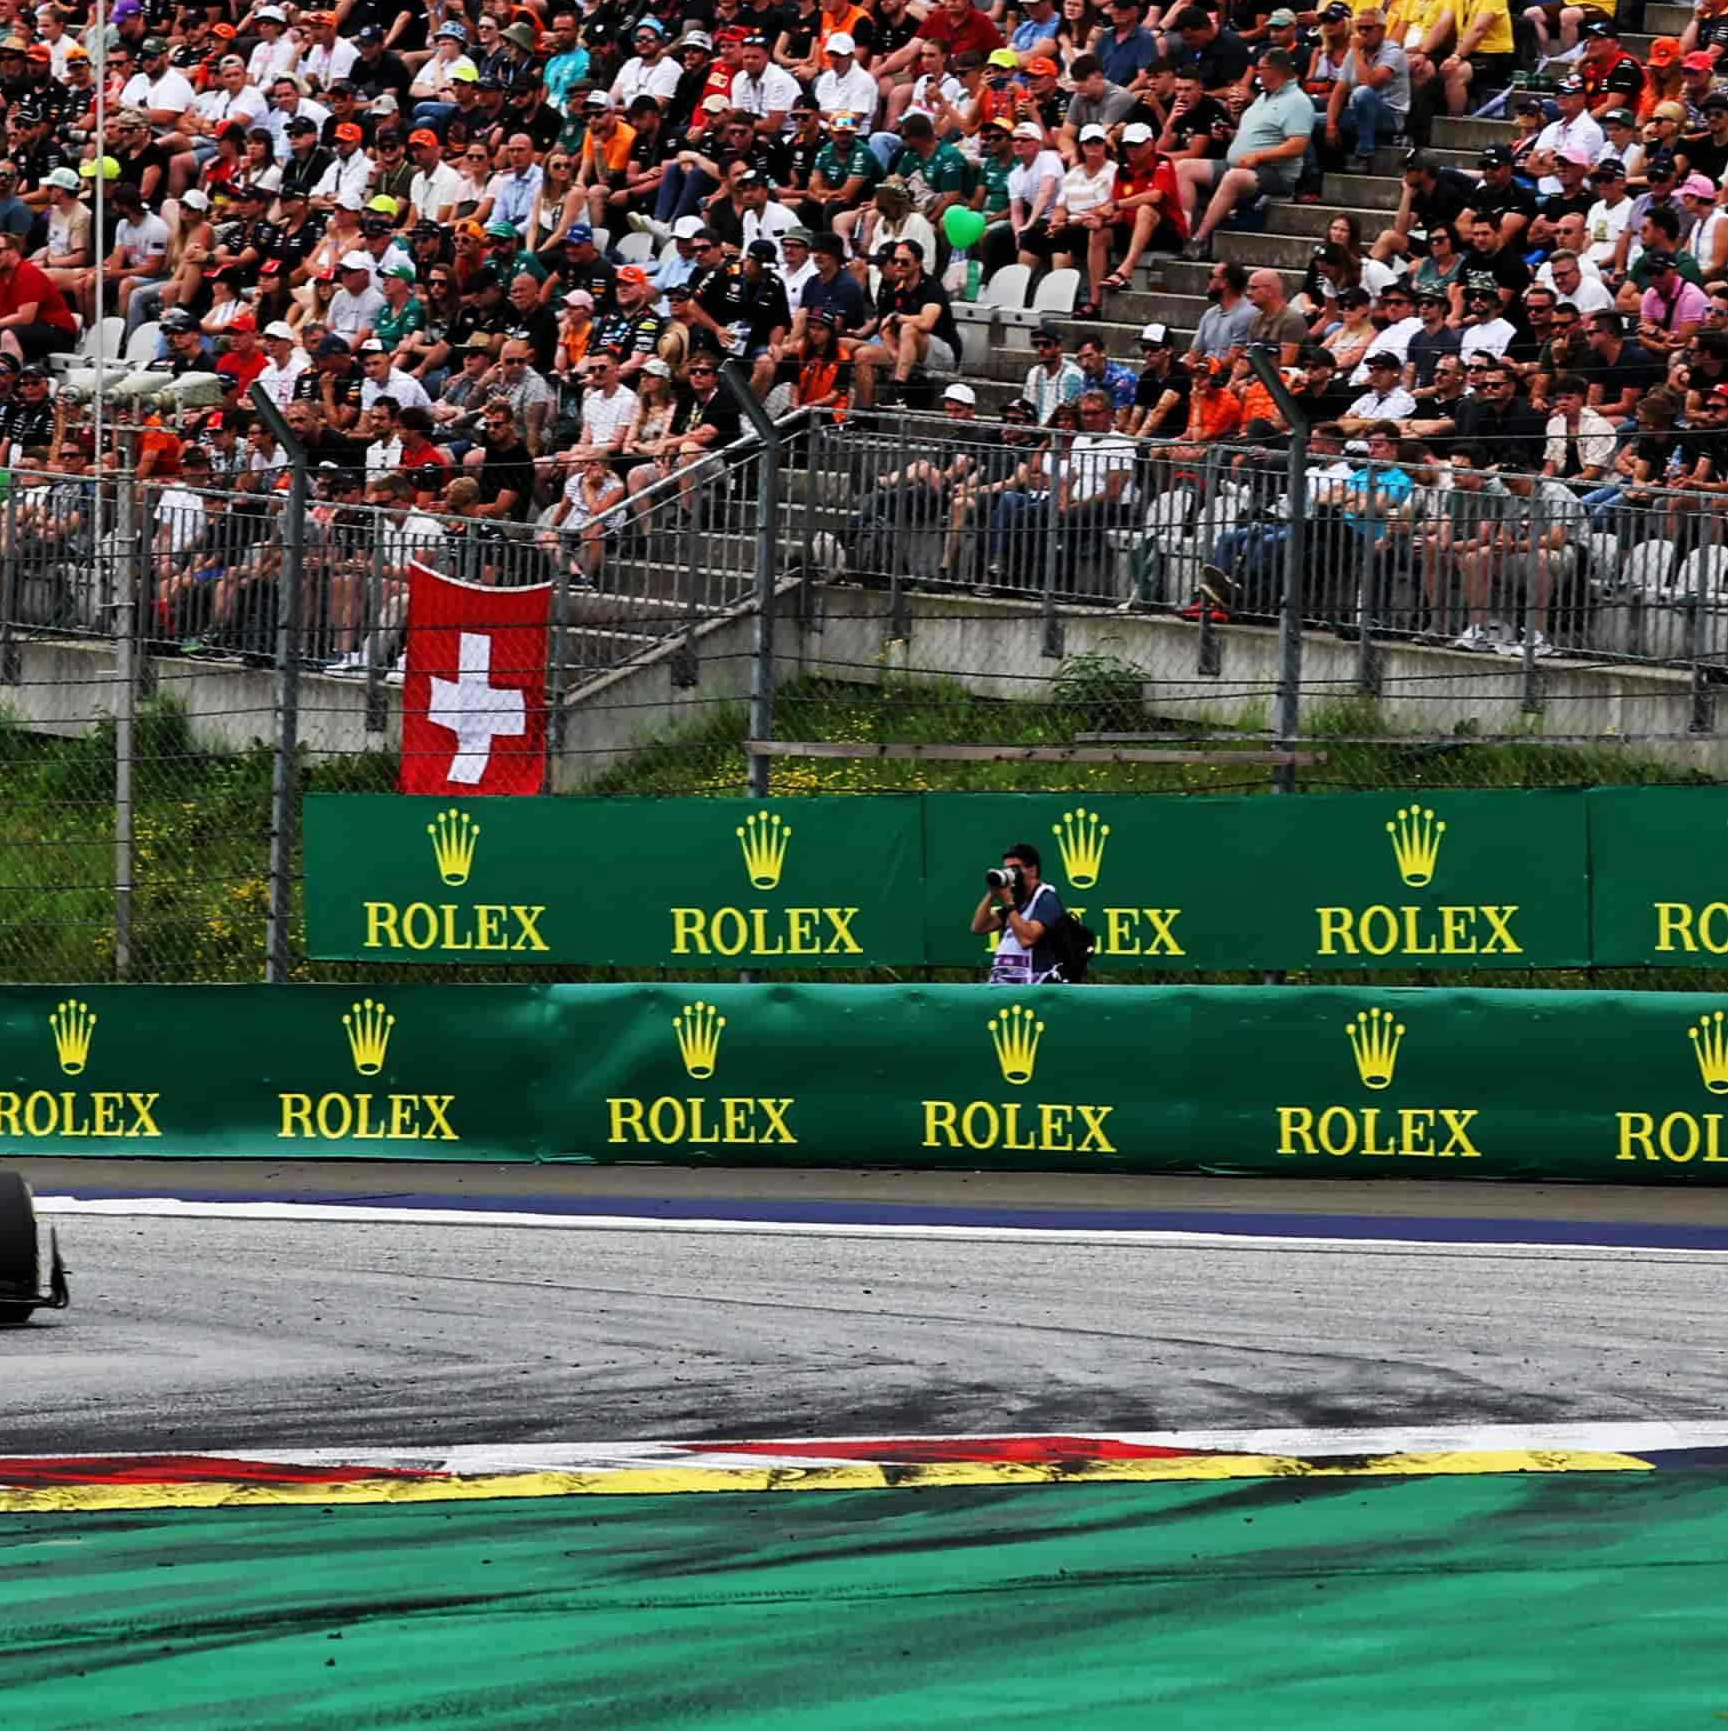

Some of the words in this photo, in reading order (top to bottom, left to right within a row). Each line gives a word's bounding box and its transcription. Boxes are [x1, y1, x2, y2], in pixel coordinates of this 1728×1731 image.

[363, 901, 549, 952] ROLEX
[671, 907, 863, 956] ROLEX
[1317, 904, 1522, 955] ROLEX
[278, 1092, 460, 1141] ROLEX
[607, 1096, 798, 1145] ROLEX
[922, 1100, 1117, 1153] ROLEX
[1276, 1105, 1481, 1159] ROLEX
